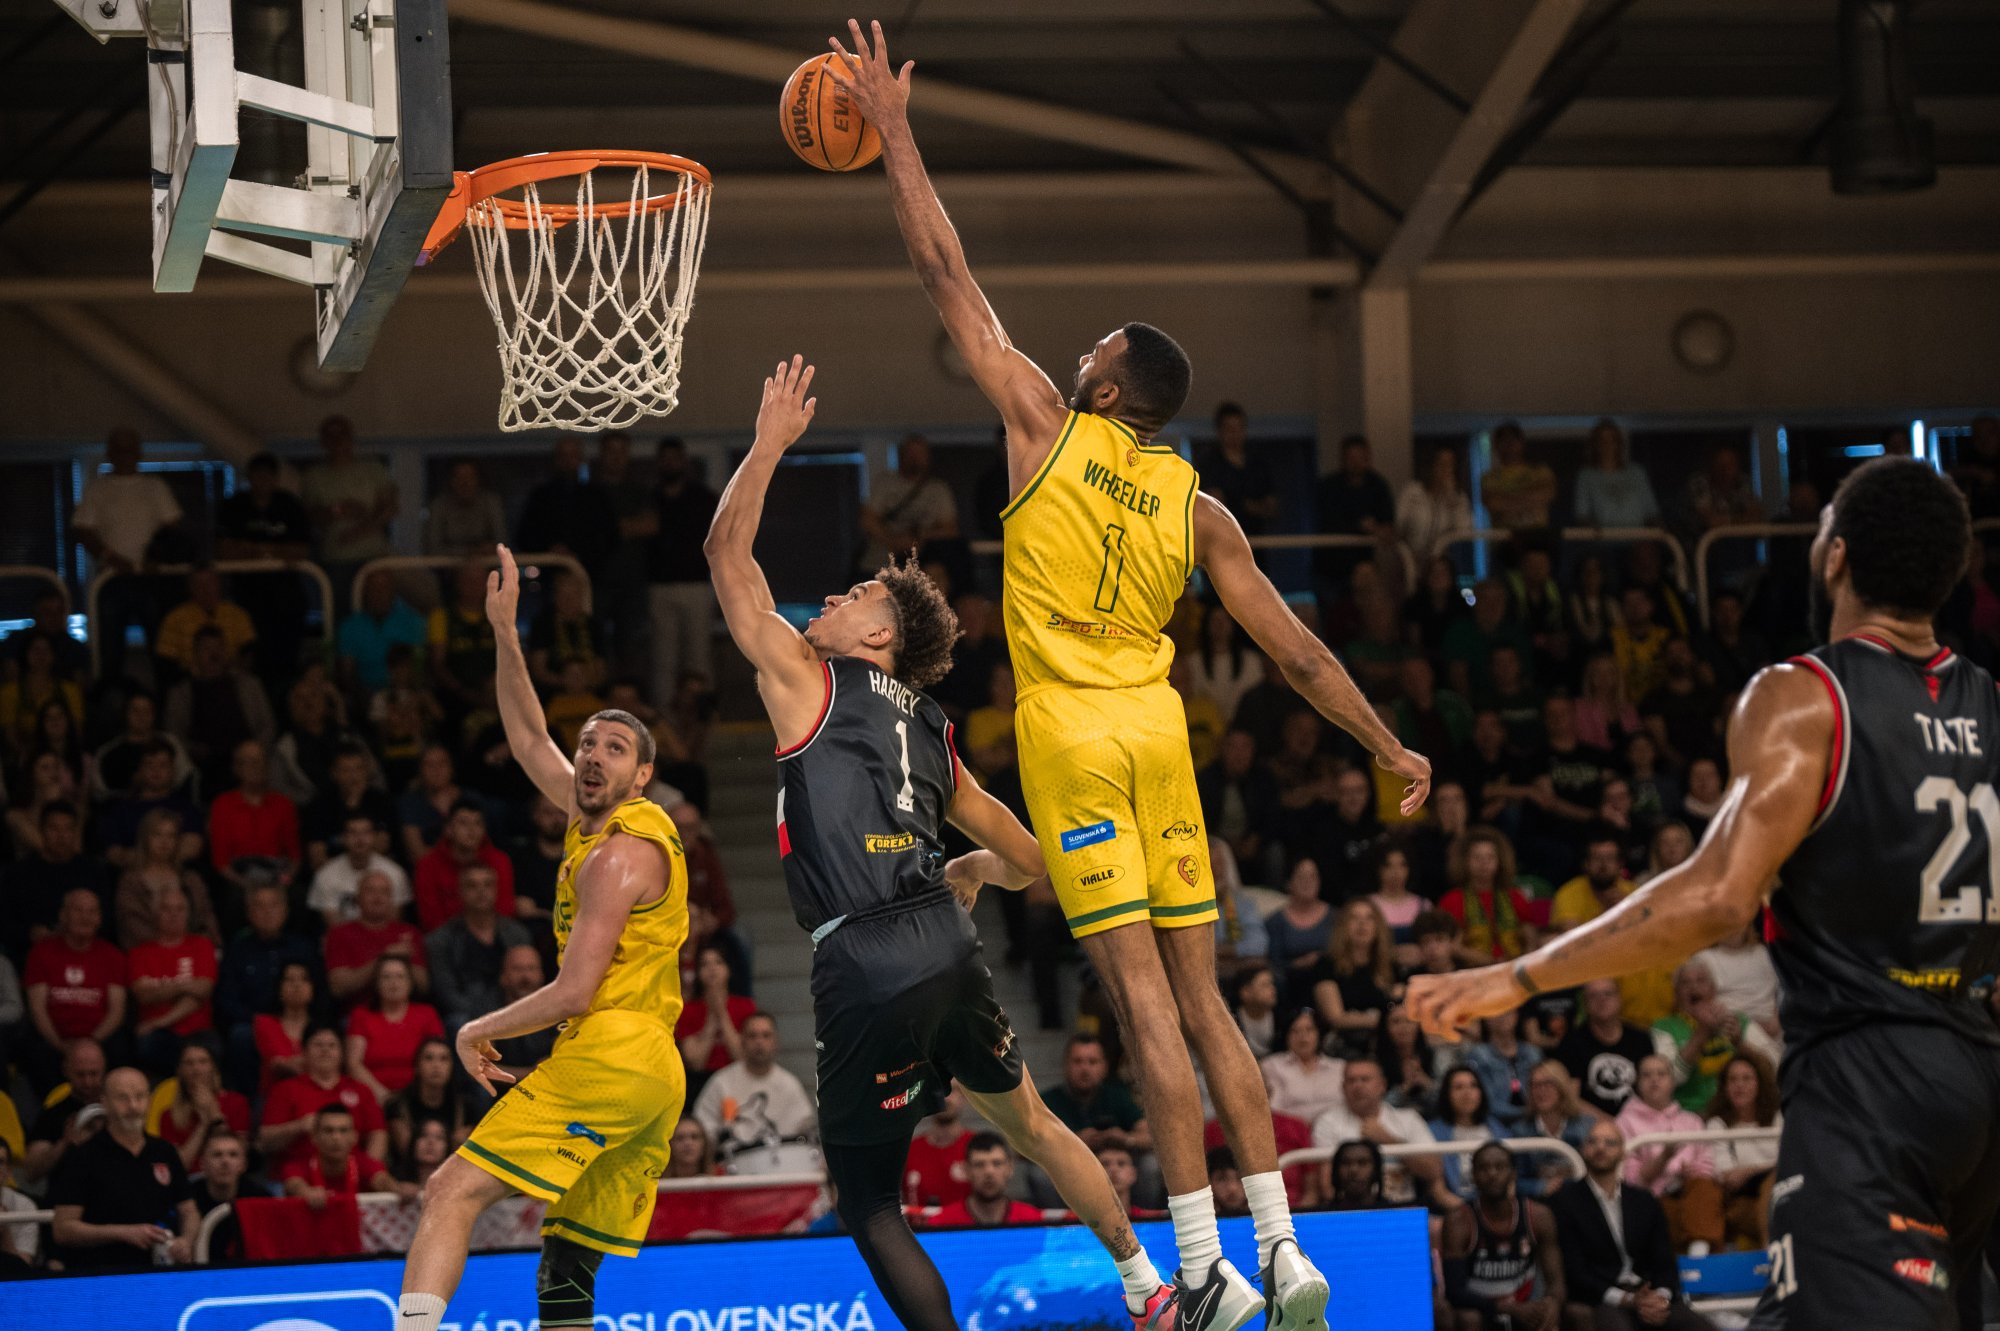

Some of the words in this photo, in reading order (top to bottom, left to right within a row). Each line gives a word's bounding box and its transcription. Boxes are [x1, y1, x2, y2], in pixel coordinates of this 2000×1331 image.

[791, 68, 817, 149] Wilson
[1083, 459, 1161, 518] WHEELER
[1094, 523, 1125, 613] 1
[868, 670, 920, 717] HARVEY
[1913, 711, 1983, 756] TATE
[895, 720, 914, 812] 1
[1080, 869, 1115, 887] VIALLE
[1914, 775, 2000, 923] 21
[556, 1146, 587, 1168] VIALLE
